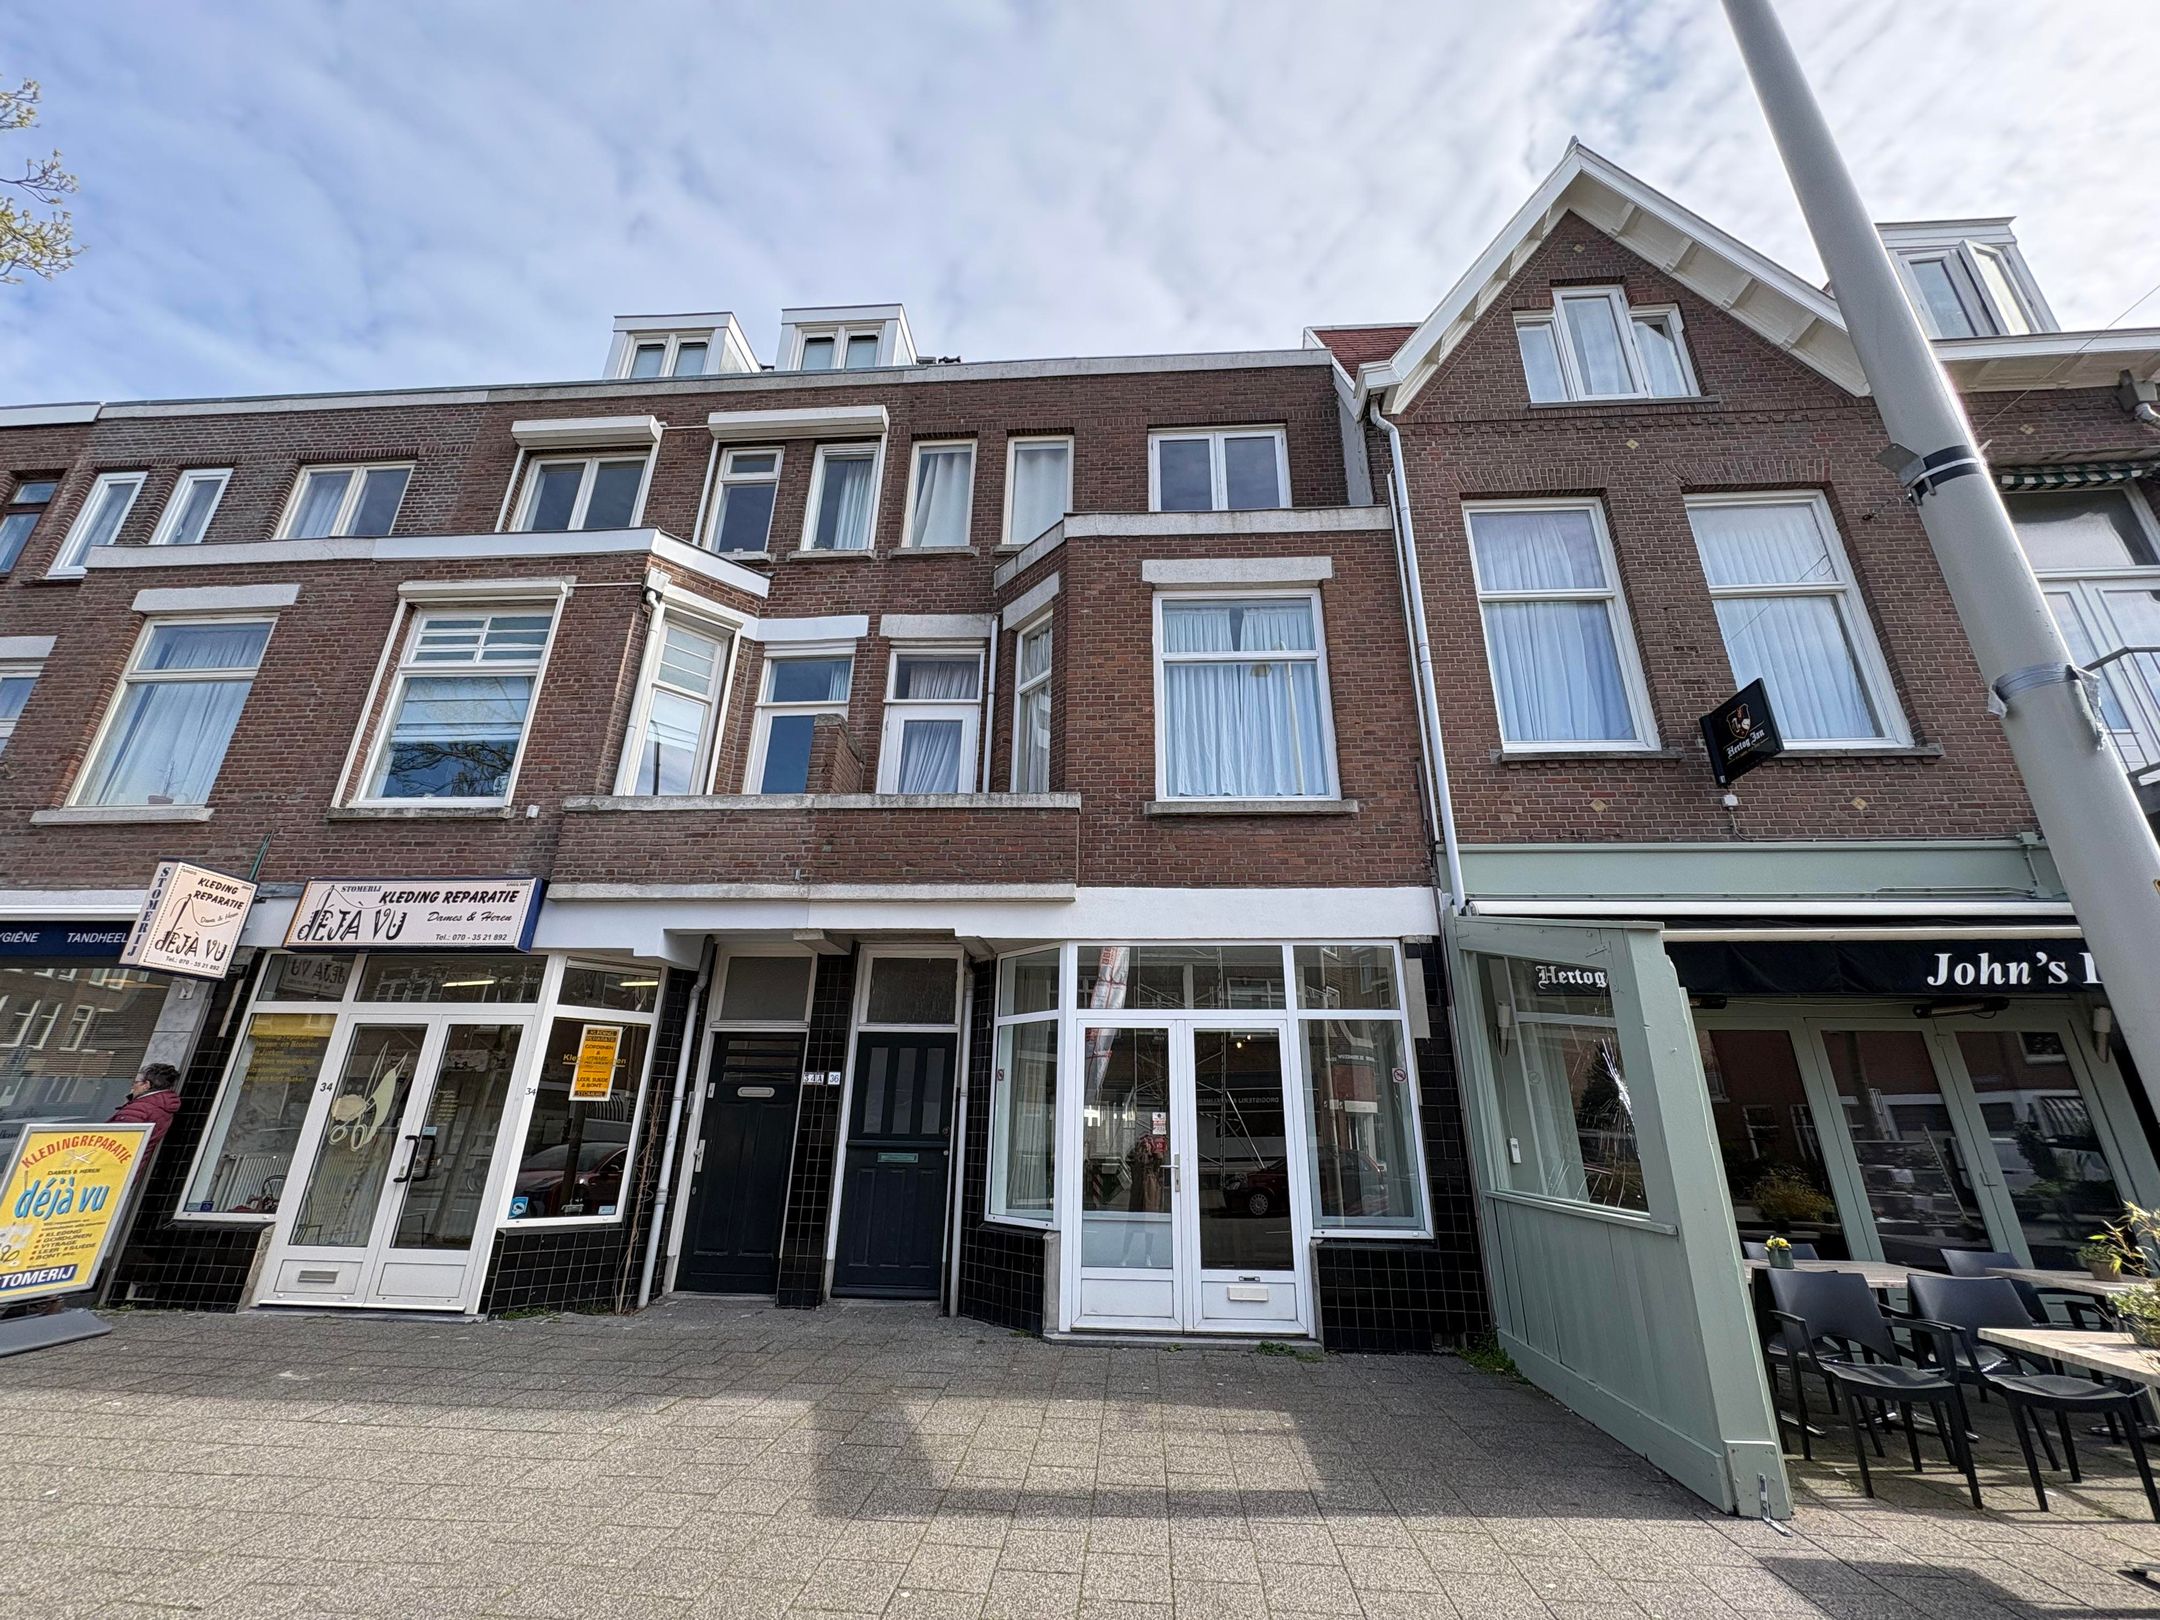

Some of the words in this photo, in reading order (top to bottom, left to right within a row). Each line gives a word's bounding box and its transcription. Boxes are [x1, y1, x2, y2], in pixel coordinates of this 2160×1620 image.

[198, 877, 239, 895] KLEDING
[341, 885, 382, 893] STOMERIJ
[193, 890, 245, 910] REPARATIE
[378, 891, 440, 905] KLEDING
[441, 890, 520, 904] REPARATIE
[127, 866, 171, 956] STOMERIJ
[427, 911, 462, 922] Dames
[466, 911, 477, 922] &
[481, 911, 512, 922] Heren
[452, 933, 466, 941] 070
[472, 933, 481, 941] 35
[482, 933, 491, 941] 21
[493, 933, 508, 941] 892
[1926, 951, 2069, 986] John's
[1535, 965, 1608, 989] Hertog
[320, 1082, 334, 1092] 34
[525, 1087, 536, 1096] 34
[22, 1135, 132, 1169] KLEDINGREPARATIE
[15, 1176, 75, 1221] déjà
[79, 1184, 110, 1213] vu
[41, 1240, 77, 1249] VITRAGE
[35, 1252, 60, 1260] BONT
